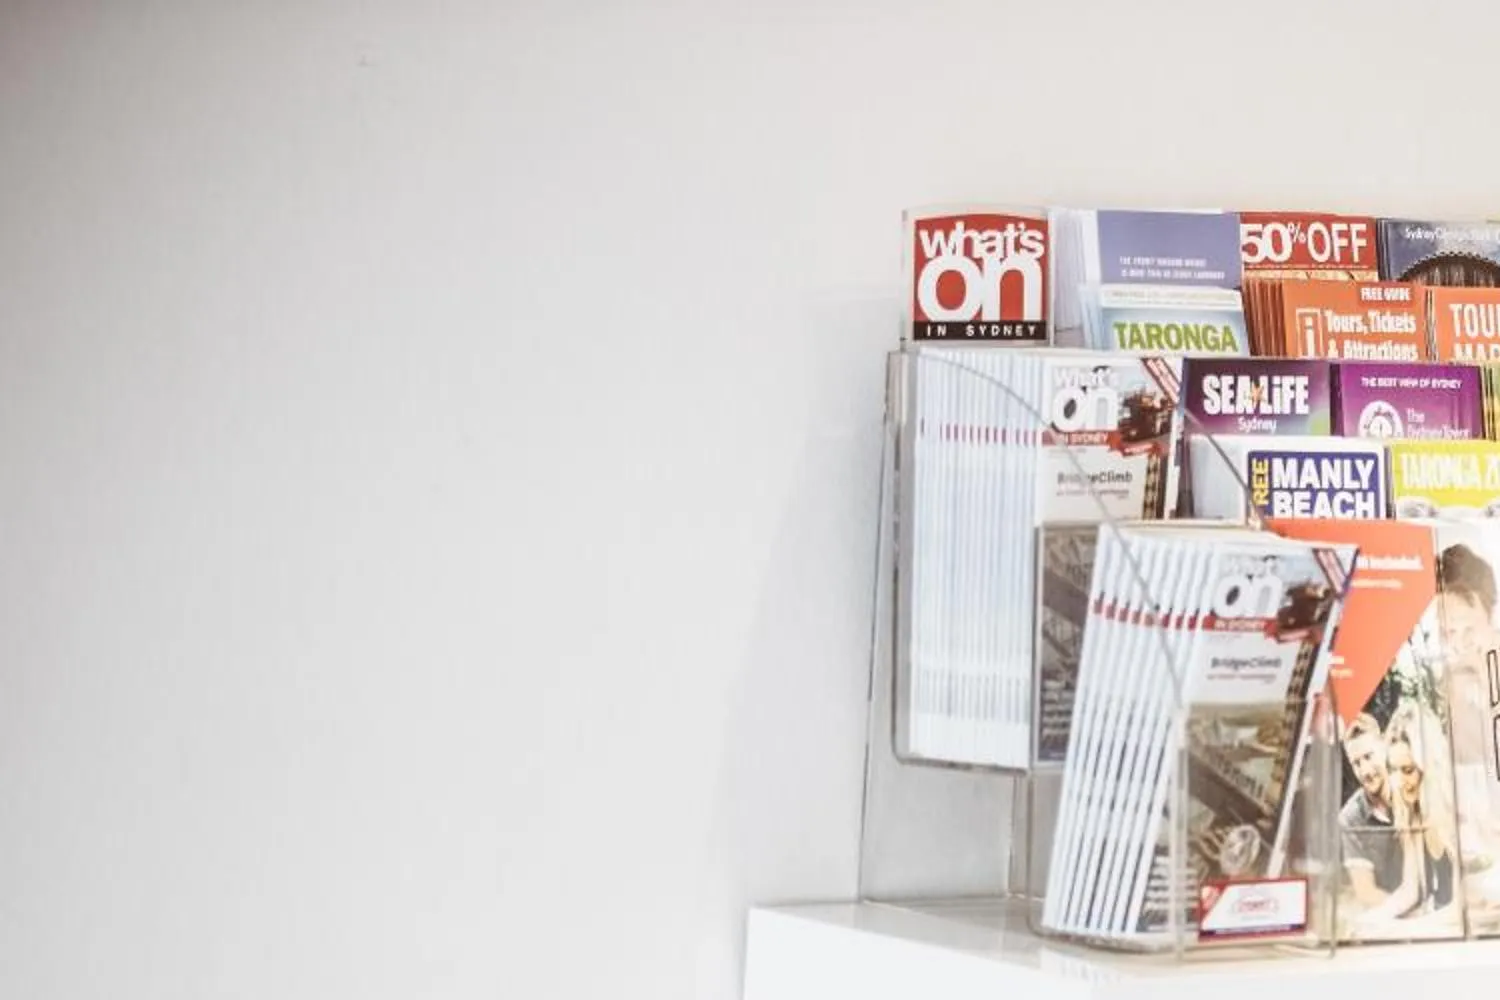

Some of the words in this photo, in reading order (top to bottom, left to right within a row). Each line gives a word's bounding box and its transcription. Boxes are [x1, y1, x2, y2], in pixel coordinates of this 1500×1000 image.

[919, 220, 1045, 259] what's
[1240, 221, 1306, 263] 50%
[1307, 222, 1367, 263] OFF
[917, 254, 1043, 322] on
[1361, 287, 1384, 301] FREE
[926, 324, 947, 337] IN
[965, 324, 1037, 338] SYDNEY
[1324, 309, 1367, 335] Tours,
[1368, 310, 1416, 334] Tickets
[1112, 322, 1239, 352] TARONGA
[1343, 339, 1419, 361] Attractions
[1203, 375, 1254, 415] SEA
[1361, 377, 1376, 387] THE
[1378, 377, 1397, 387] BEST
[1432, 379, 1462, 389] SYDNEY
[1238, 417, 1278, 434] Sydney
[1406, 408, 1425, 423] The
[1252, 457, 1270, 506] FREE
[1272, 458, 1375, 490] MANLY
[1272, 491, 1375, 519] BEACH
